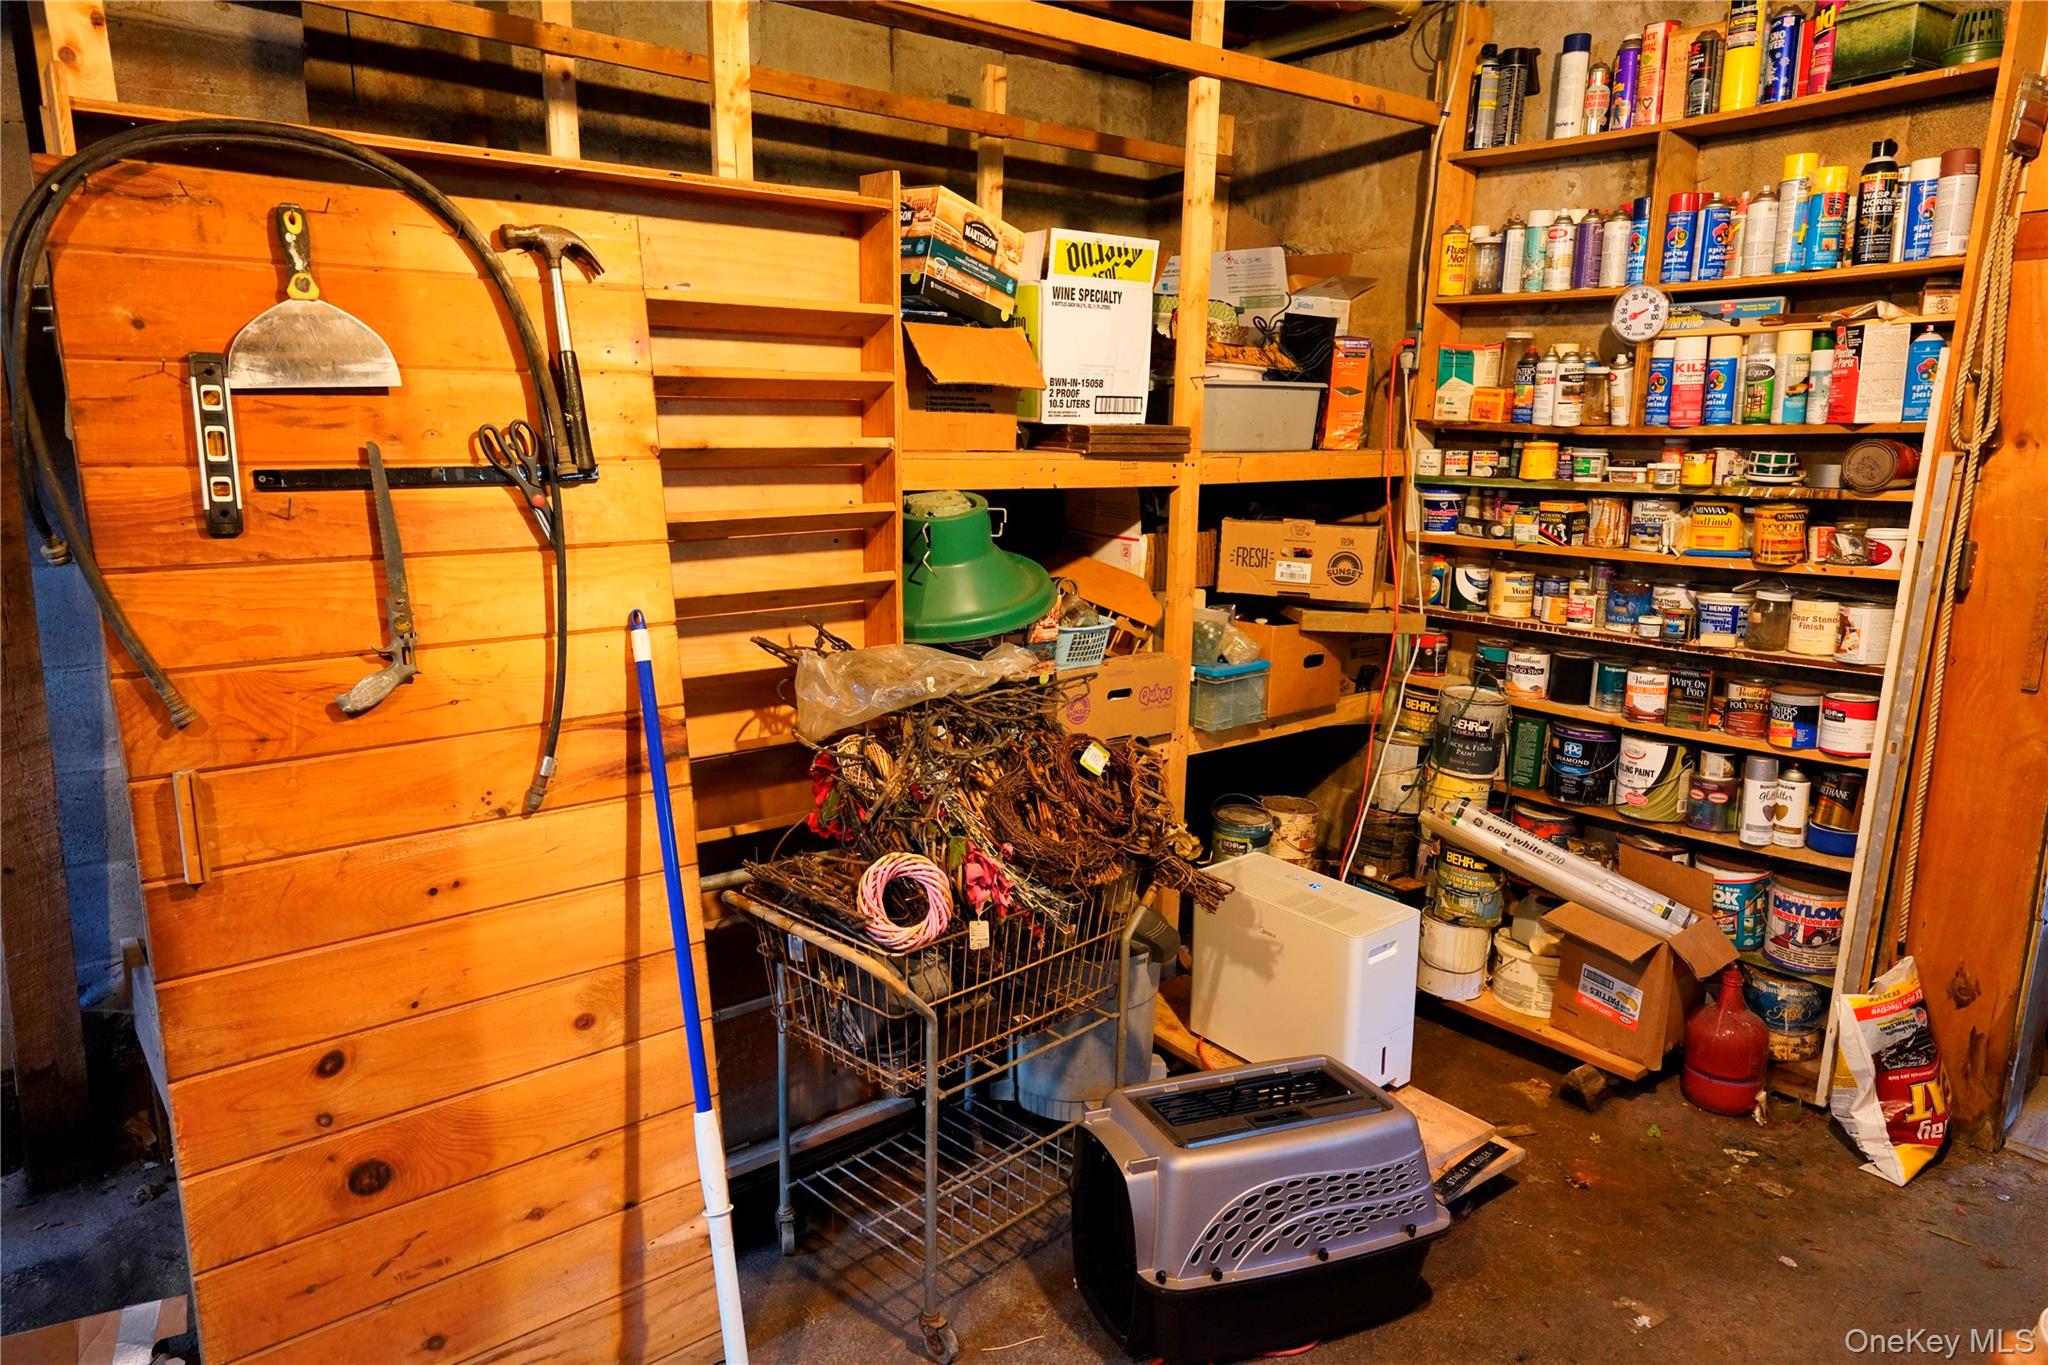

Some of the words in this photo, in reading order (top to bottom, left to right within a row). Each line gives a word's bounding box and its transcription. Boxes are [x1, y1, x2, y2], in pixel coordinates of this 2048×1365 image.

[1814, 4, 1837, 34] aid
[1864, 191, 1889, 200] WASP
[1863, 198, 1896, 207] HORNE
[1862, 206, 1893, 214] KILLER
[965, 225, 998, 251] MARTINSON
[1052, 286, 1076, 301] WINE
[1079, 288, 1123, 305] SPECIALTY
[1632, 293, 1639, 301] 20
[1650, 313, 1660, 321] 100
[1644, 322, 1654, 330] 120
[1683, 320, 1704, 329] PUMP
[1675, 363, 1707, 374] KILZ
[1049, 377, 1104, 389] BWN-IN-15058
[1049, 388, 1055, 398] 2
[1056, 389, 1080, 399] PROOF
[1706, 393, 1728, 401] pray
[1049, 399, 1064, 409] 10.5
[1066, 399, 1090, 409] LITERS
[1696, 506, 1727, 515] MINWAX
[1707, 517, 1733, 527] Finish
[1340, 537, 1355, 547] FROM
[1236, 547, 1269, 568] FRESH
[1327, 568, 1364, 579] SUNSET
[1799, 622, 1825, 631] Finish
[1633, 674, 1665, 687] Varathane
[1672, 676, 1692, 688] WIPE
[1694, 679, 1707, 690] ON
[1686, 686, 1706, 698] POLY
[1406, 698, 1430, 712] BEHR
[1729, 701, 1747, 709] POLY
[1754, 702, 1769, 711] STA
[1825, 709, 1839, 717] BEHR
[1453, 727, 1475, 737] REMIUM
[1472, 742, 1493, 752] FLOOR
[1565, 743, 1582, 755] PPG
[1456, 748, 1477, 758] PAINT
[1556, 754, 1590, 766] DIAMOND
[1635, 766, 1656, 778] PAINT
[1822, 785, 1850, 800] ETHANE
[1487, 824, 1512, 839] cool
[1513, 836, 1544, 856] white
[1446, 851, 1474, 868] BEHR
[1712, 891, 1740, 906] OK
[1773, 895, 1843, 920] DRYLOK
[1801, 918, 1823, 927] FLOOR
[1589, 986, 1620, 1006] PATTIES
[1917, 1119, 1944, 1140] ay
